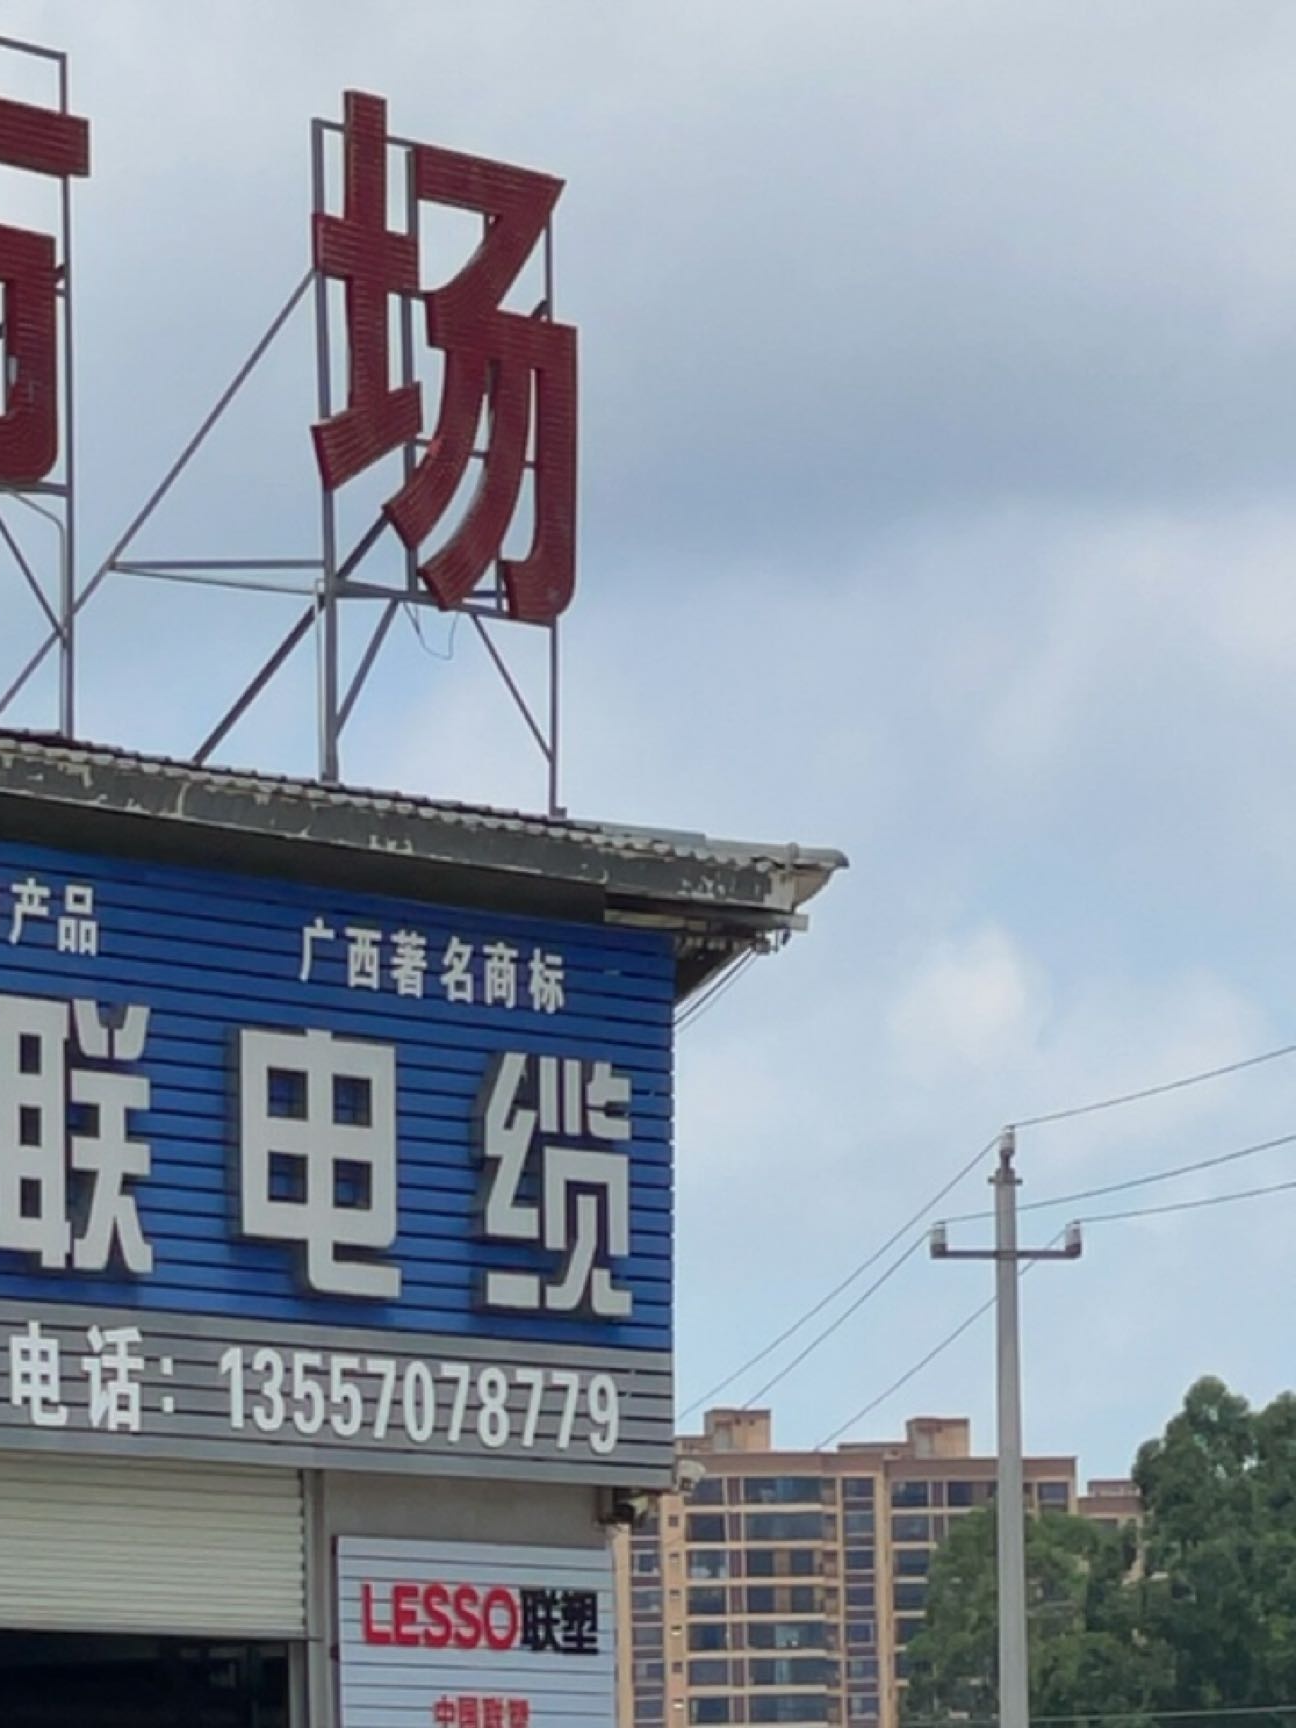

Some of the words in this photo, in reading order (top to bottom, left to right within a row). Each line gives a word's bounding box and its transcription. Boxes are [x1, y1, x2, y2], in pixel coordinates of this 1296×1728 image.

[298, 918, 565, 1014] 广西著名商标
